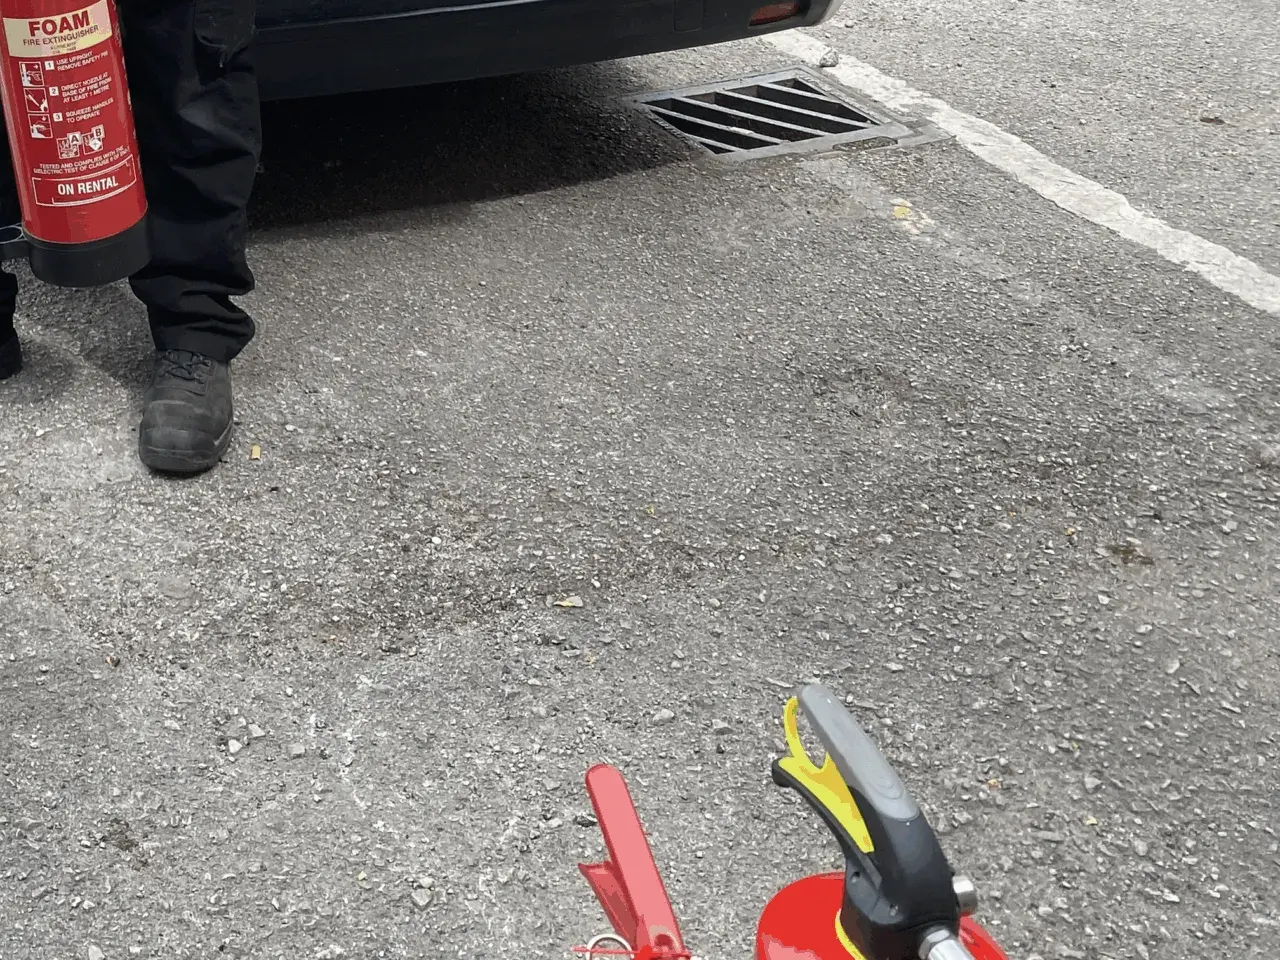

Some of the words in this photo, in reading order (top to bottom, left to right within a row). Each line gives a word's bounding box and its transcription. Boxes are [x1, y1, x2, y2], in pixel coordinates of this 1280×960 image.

[28, 10, 90, 36] FOAM
[43, 25, 98, 45] EXTINGUISHER
[58, 183, 74, 195] ON
[78, 176, 118, 194] RENTAL
